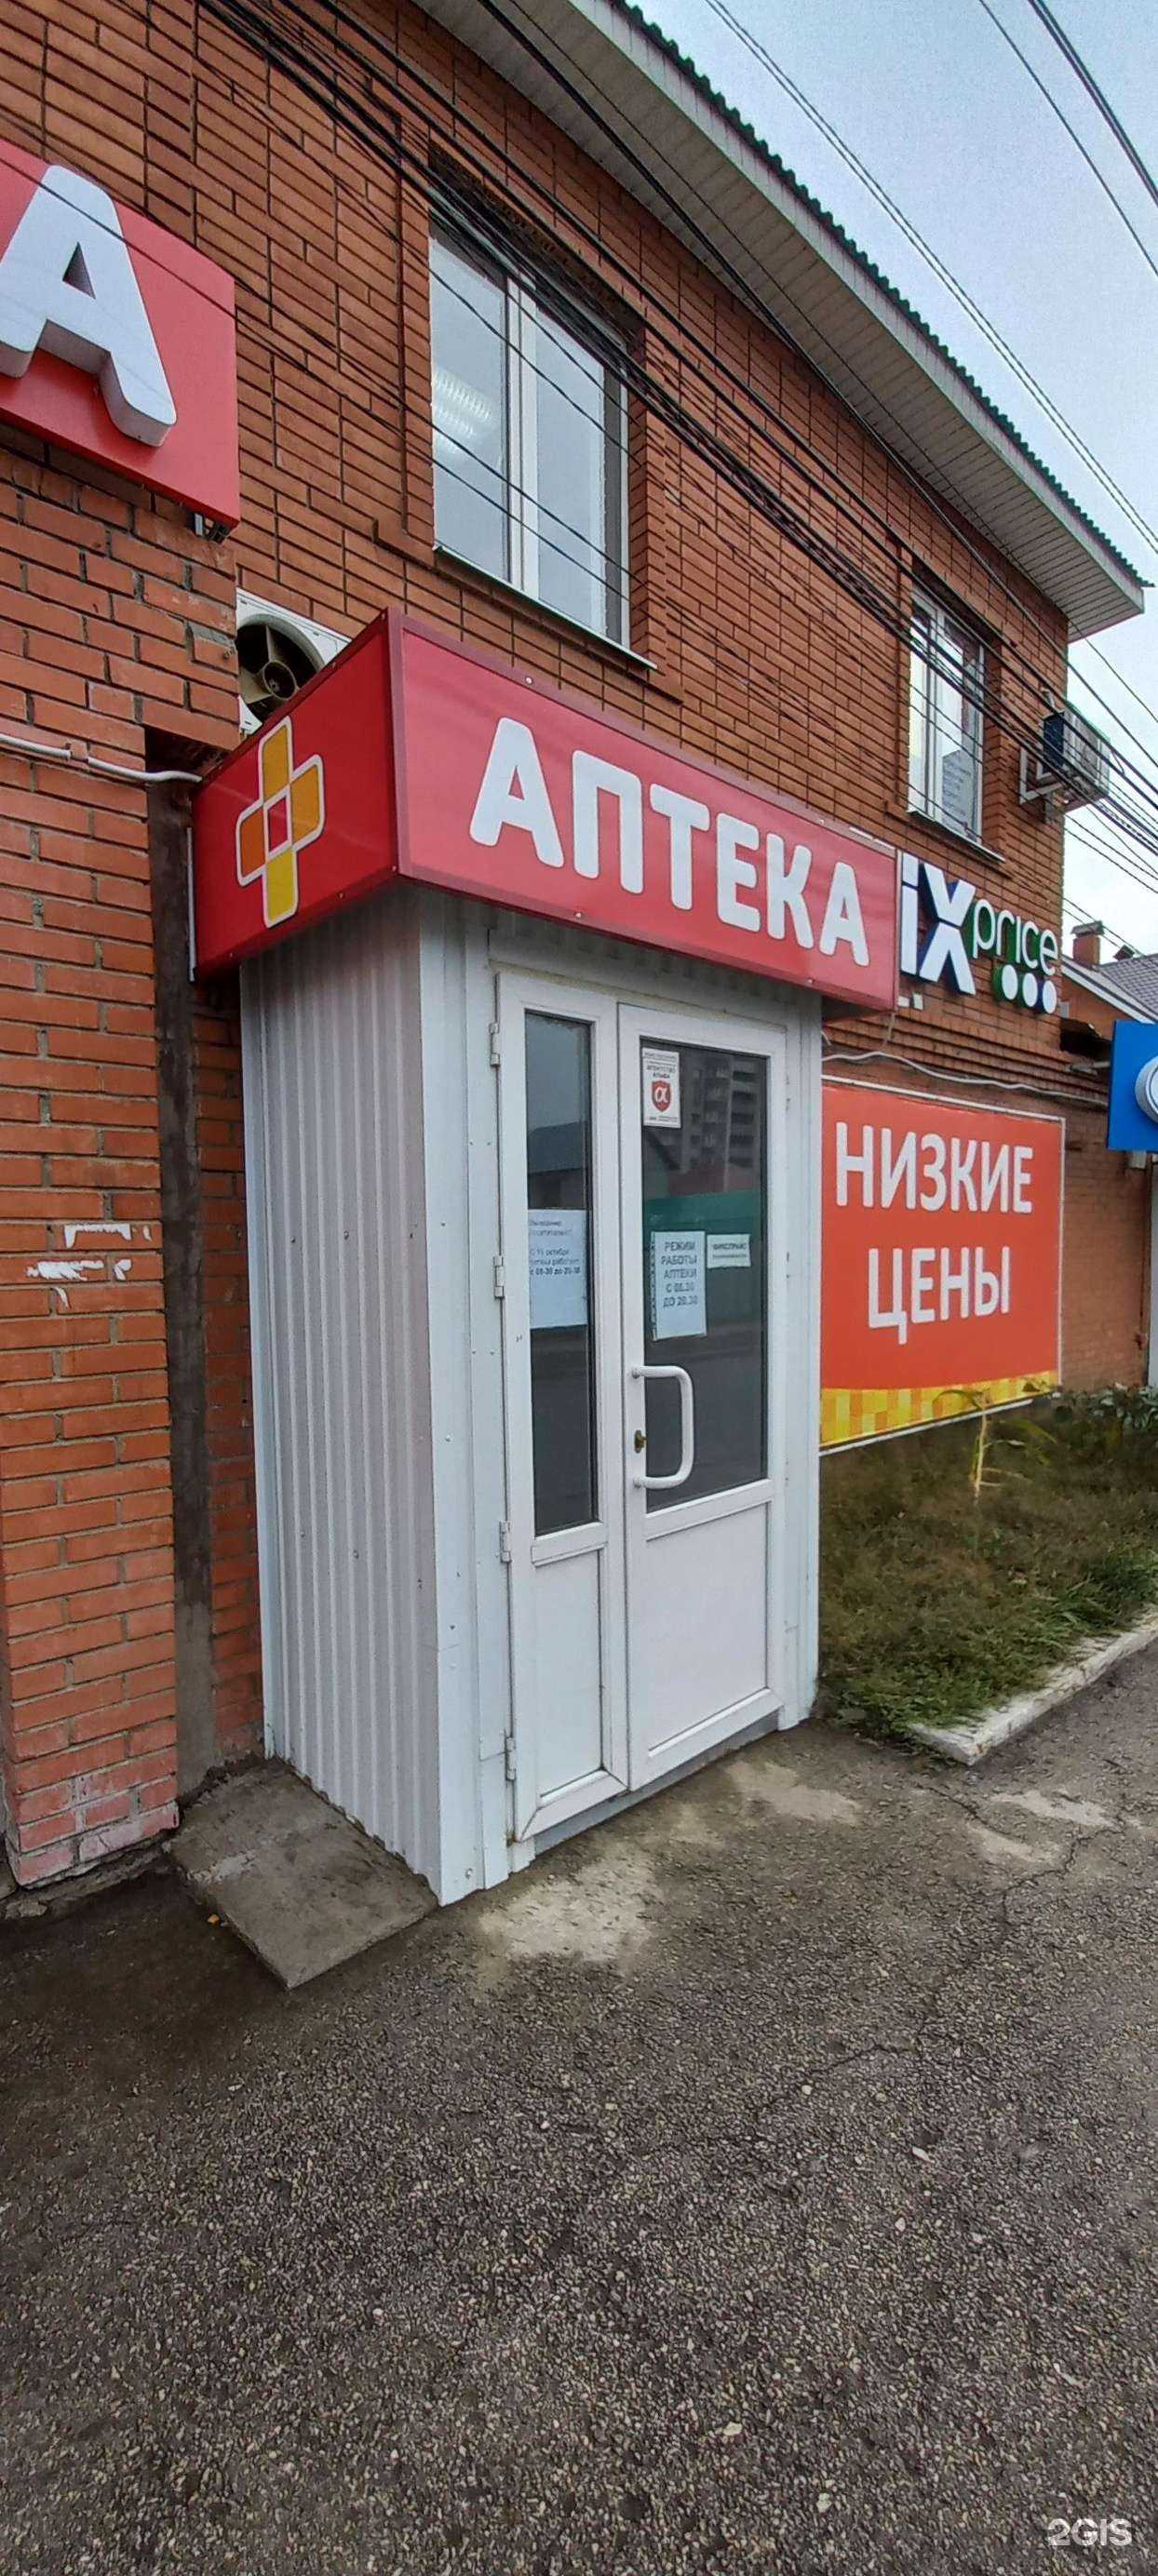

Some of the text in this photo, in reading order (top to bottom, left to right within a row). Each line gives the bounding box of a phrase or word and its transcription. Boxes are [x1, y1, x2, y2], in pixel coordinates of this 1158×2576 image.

[469, 717, 870, 967] АПТЕКА
[973, 899, 1058, 976] price
[836, 1122, 1033, 1214] НИЗКИЕ
[661, 1254, 697, 1266] РАБОТЫ
[868, 1247, 1010, 1345] ЦЕНЫ
